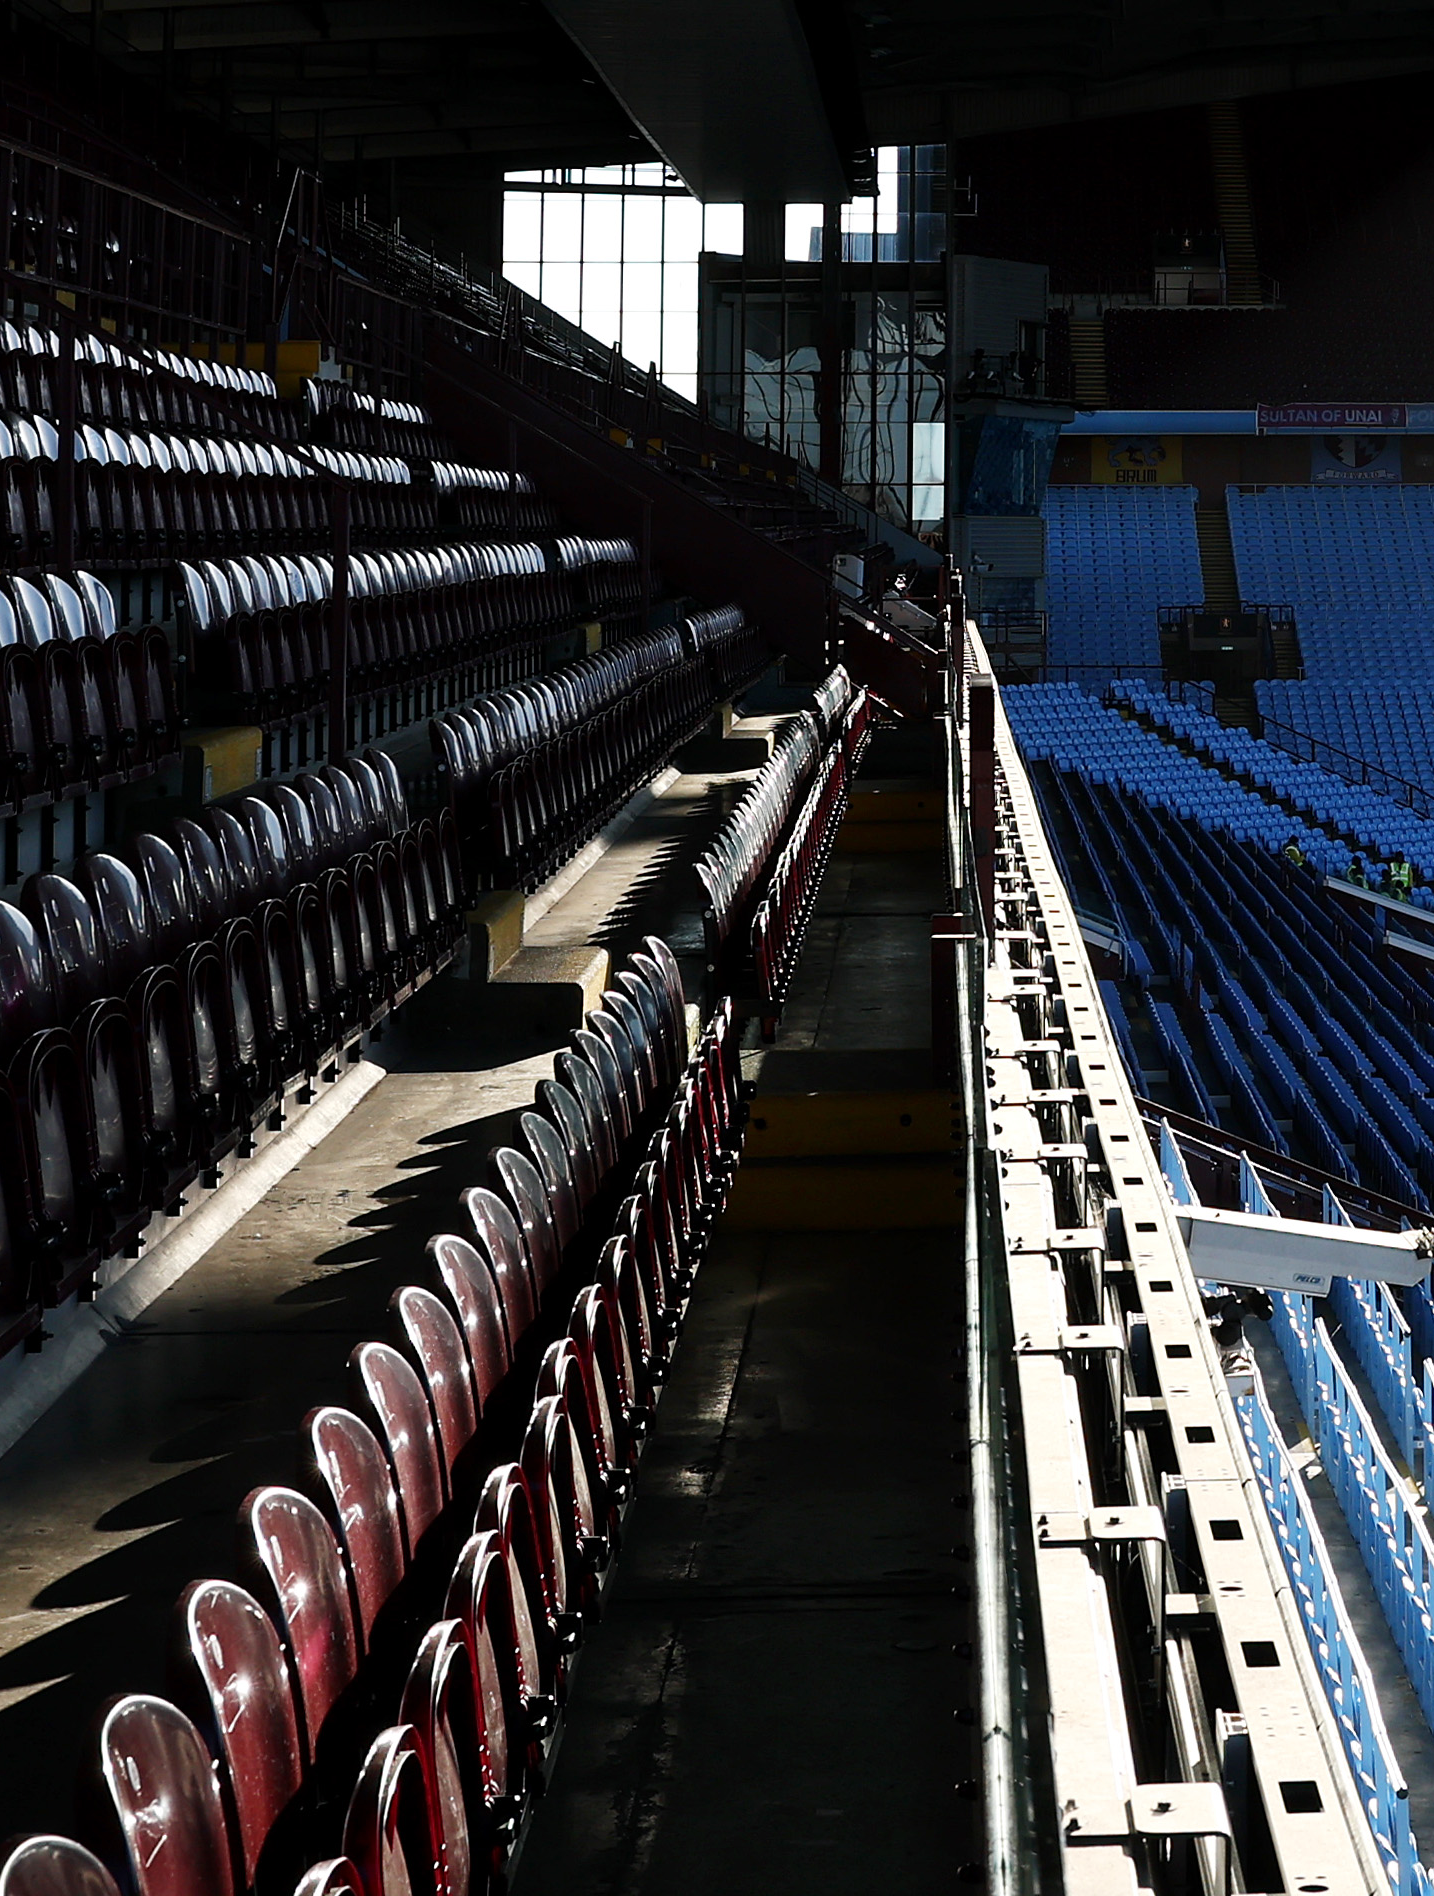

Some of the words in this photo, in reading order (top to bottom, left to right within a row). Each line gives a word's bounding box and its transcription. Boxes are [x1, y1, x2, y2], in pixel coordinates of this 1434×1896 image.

[1260, 409, 1318, 424] SULTAN
[1321, 409, 1342, 423] OF
[1344, 409, 1382, 424] UNAI
[1115, 469, 1157, 483] BRUM
